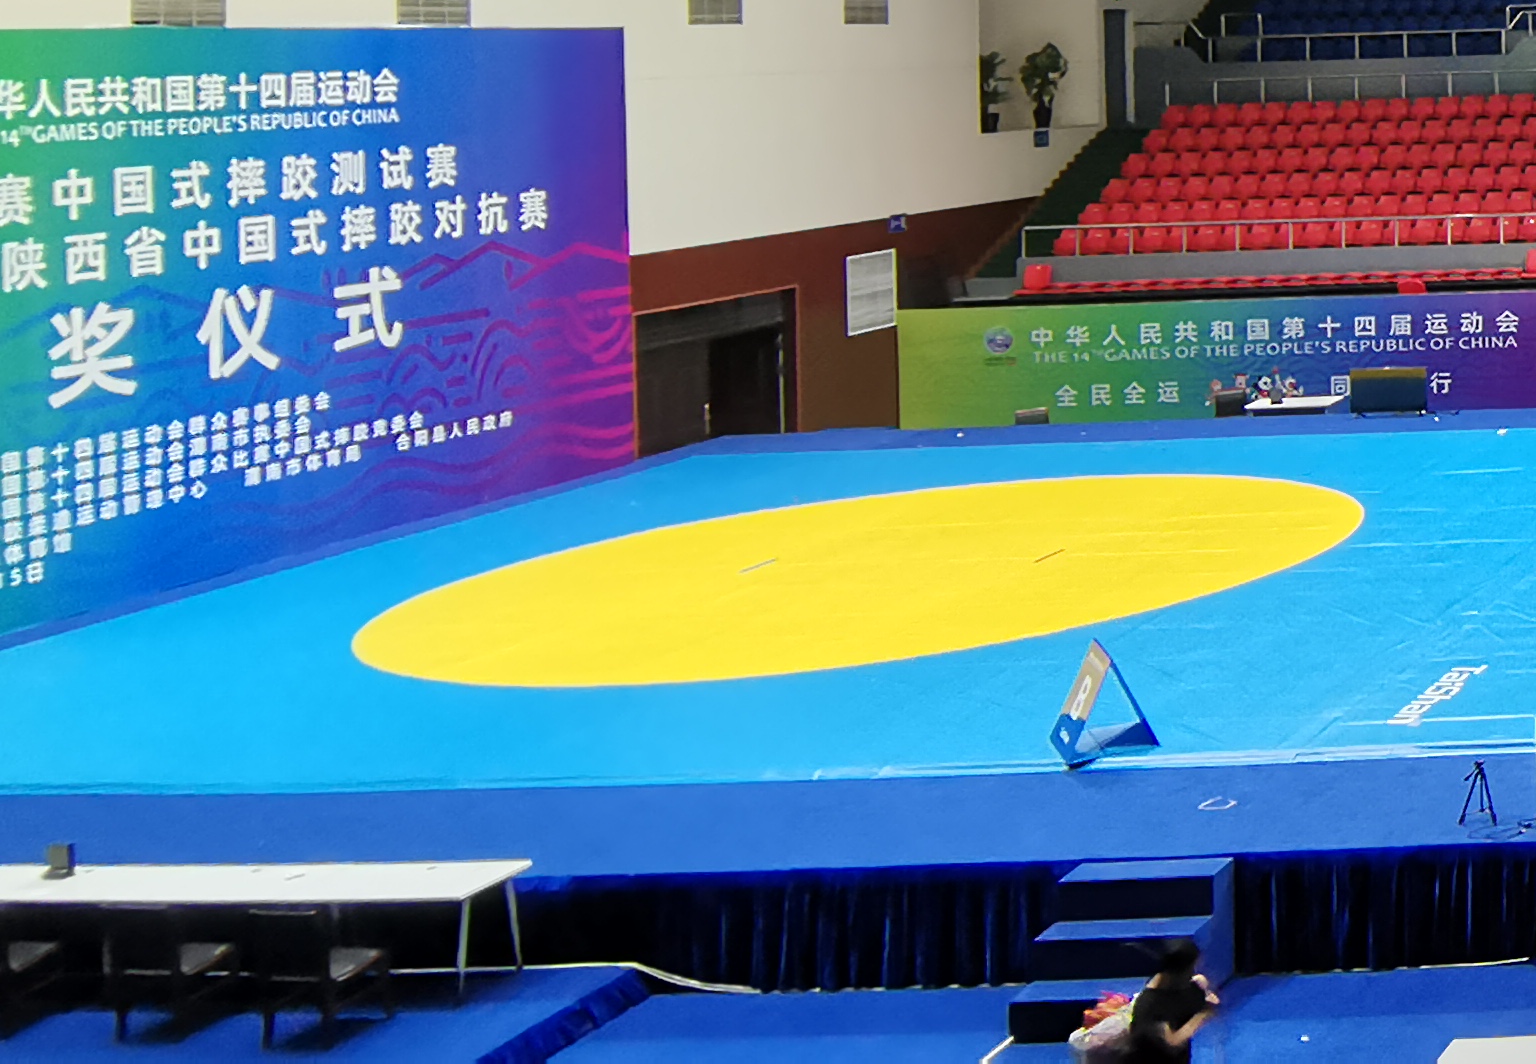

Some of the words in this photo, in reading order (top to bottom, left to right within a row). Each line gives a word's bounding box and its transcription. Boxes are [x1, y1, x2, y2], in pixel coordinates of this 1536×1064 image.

[33, 121, 98, 144] GAMES
[101, 119, 127, 140] OF
[130, 118, 163, 138] THE
[167, 114, 247, 136] PEOPLE'S
[250, 110, 326, 132] REPUBLIC
[329, 109, 350, 127] OF
[352, 106, 400, 125] CHINA
[1031, 310, 1519, 347] 中华人民共和国第十四届运动会
[1034, 350, 1067, 364] THE
[1105, 347, 1171, 362] GAMES
[1174, 345, 1199, 359] OF
[1204, 344, 1239, 358] THE
[1244, 340, 1332, 356] PEOPLE'S
[1336, 338, 1426, 353] REPUBLIC
[1430, 337, 1454, 351] OF
[1458, 336, 1518, 350] CHINA
[1055, 381, 1181, 407] 全民全运
